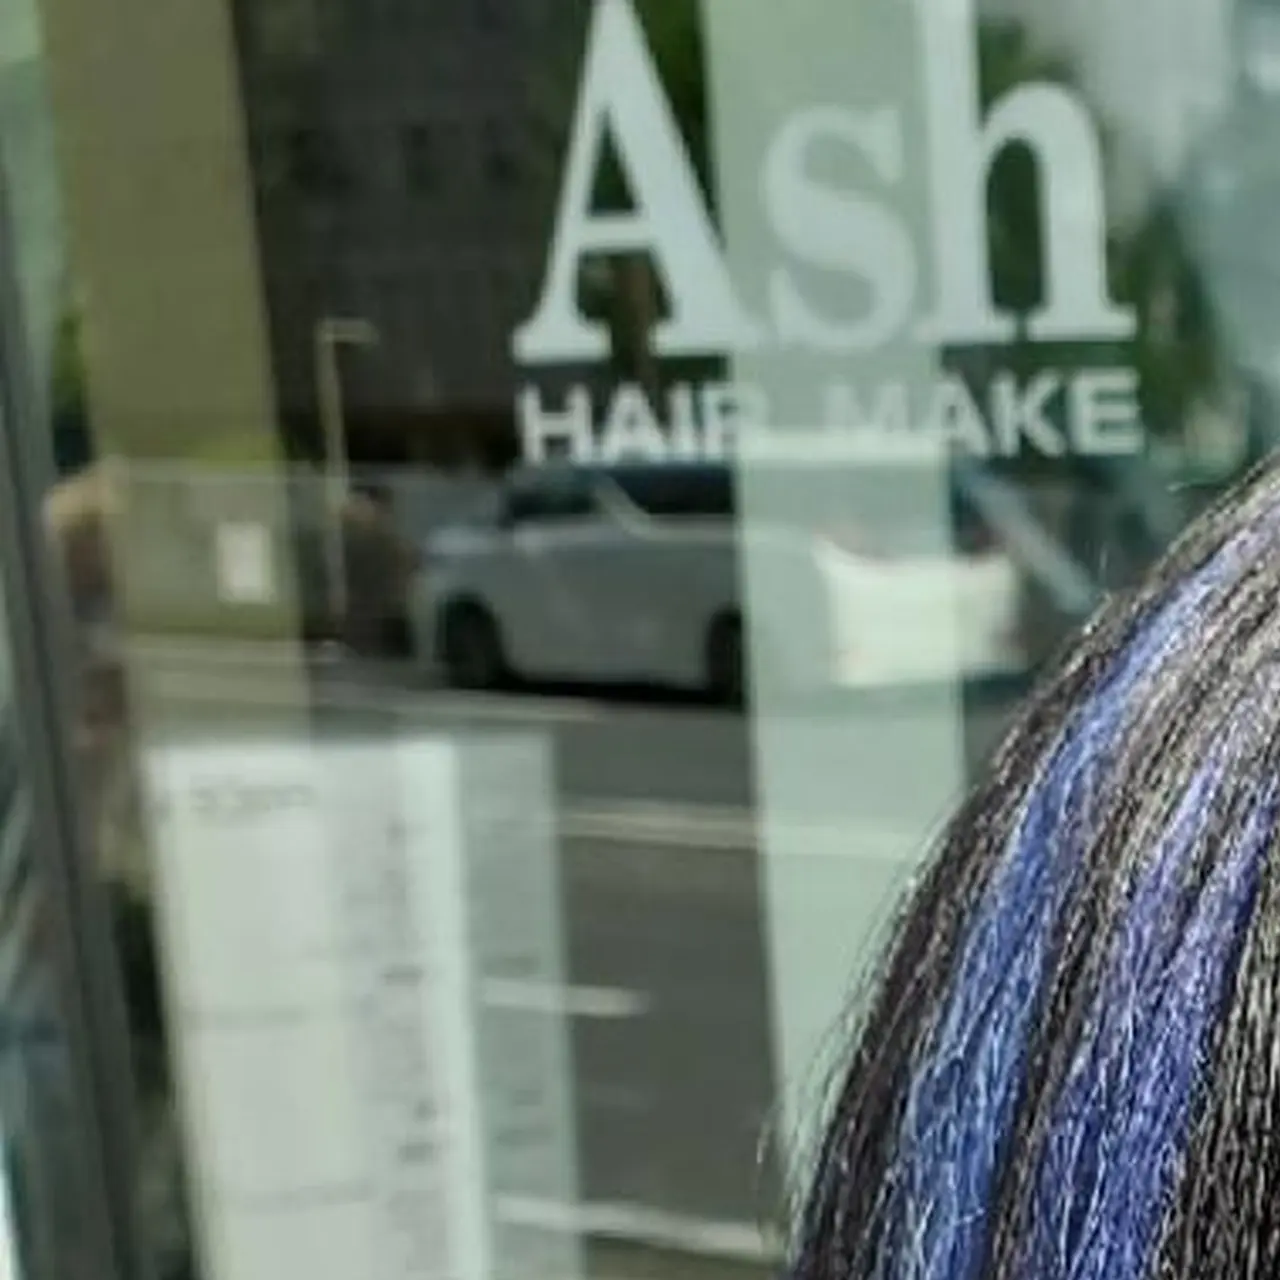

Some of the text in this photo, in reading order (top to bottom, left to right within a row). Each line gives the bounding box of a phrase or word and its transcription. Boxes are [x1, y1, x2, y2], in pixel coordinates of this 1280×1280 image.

[512, 0, 1138, 366] Ash
[517, 366, 1142, 467] HAIR MAKE
